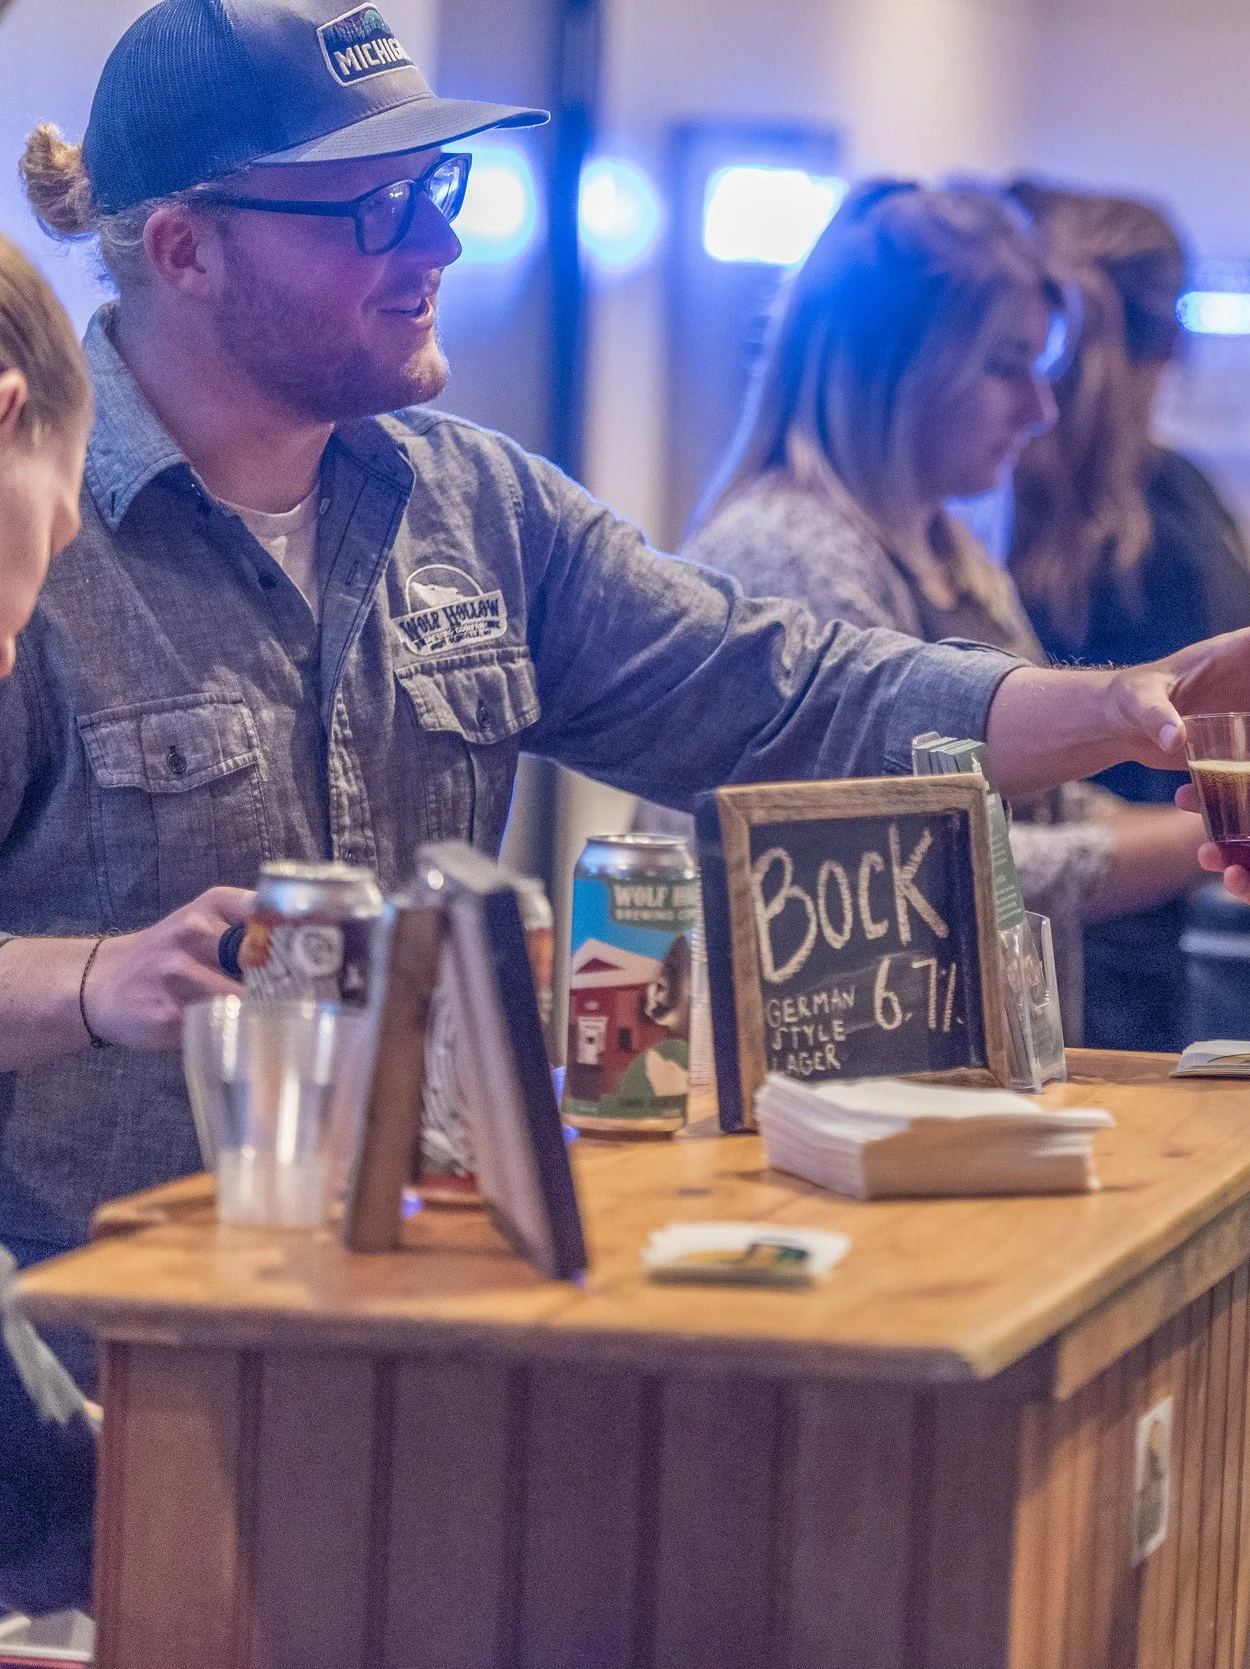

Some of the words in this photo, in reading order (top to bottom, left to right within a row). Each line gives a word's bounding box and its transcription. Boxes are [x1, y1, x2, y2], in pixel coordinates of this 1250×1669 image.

[333, 37, 410, 76] MICHIG
[398, 611, 441, 642] WOLF
[442, 599, 499, 628] HOLLOW
[613, 885, 668, 908] WOLF
[751, 822, 949, 983] BOCK
[766, 985, 856, 1028] GERMAN
[771, 1019, 847, 1051] STYLE
[770, 1043, 842, 1076] LAGER
